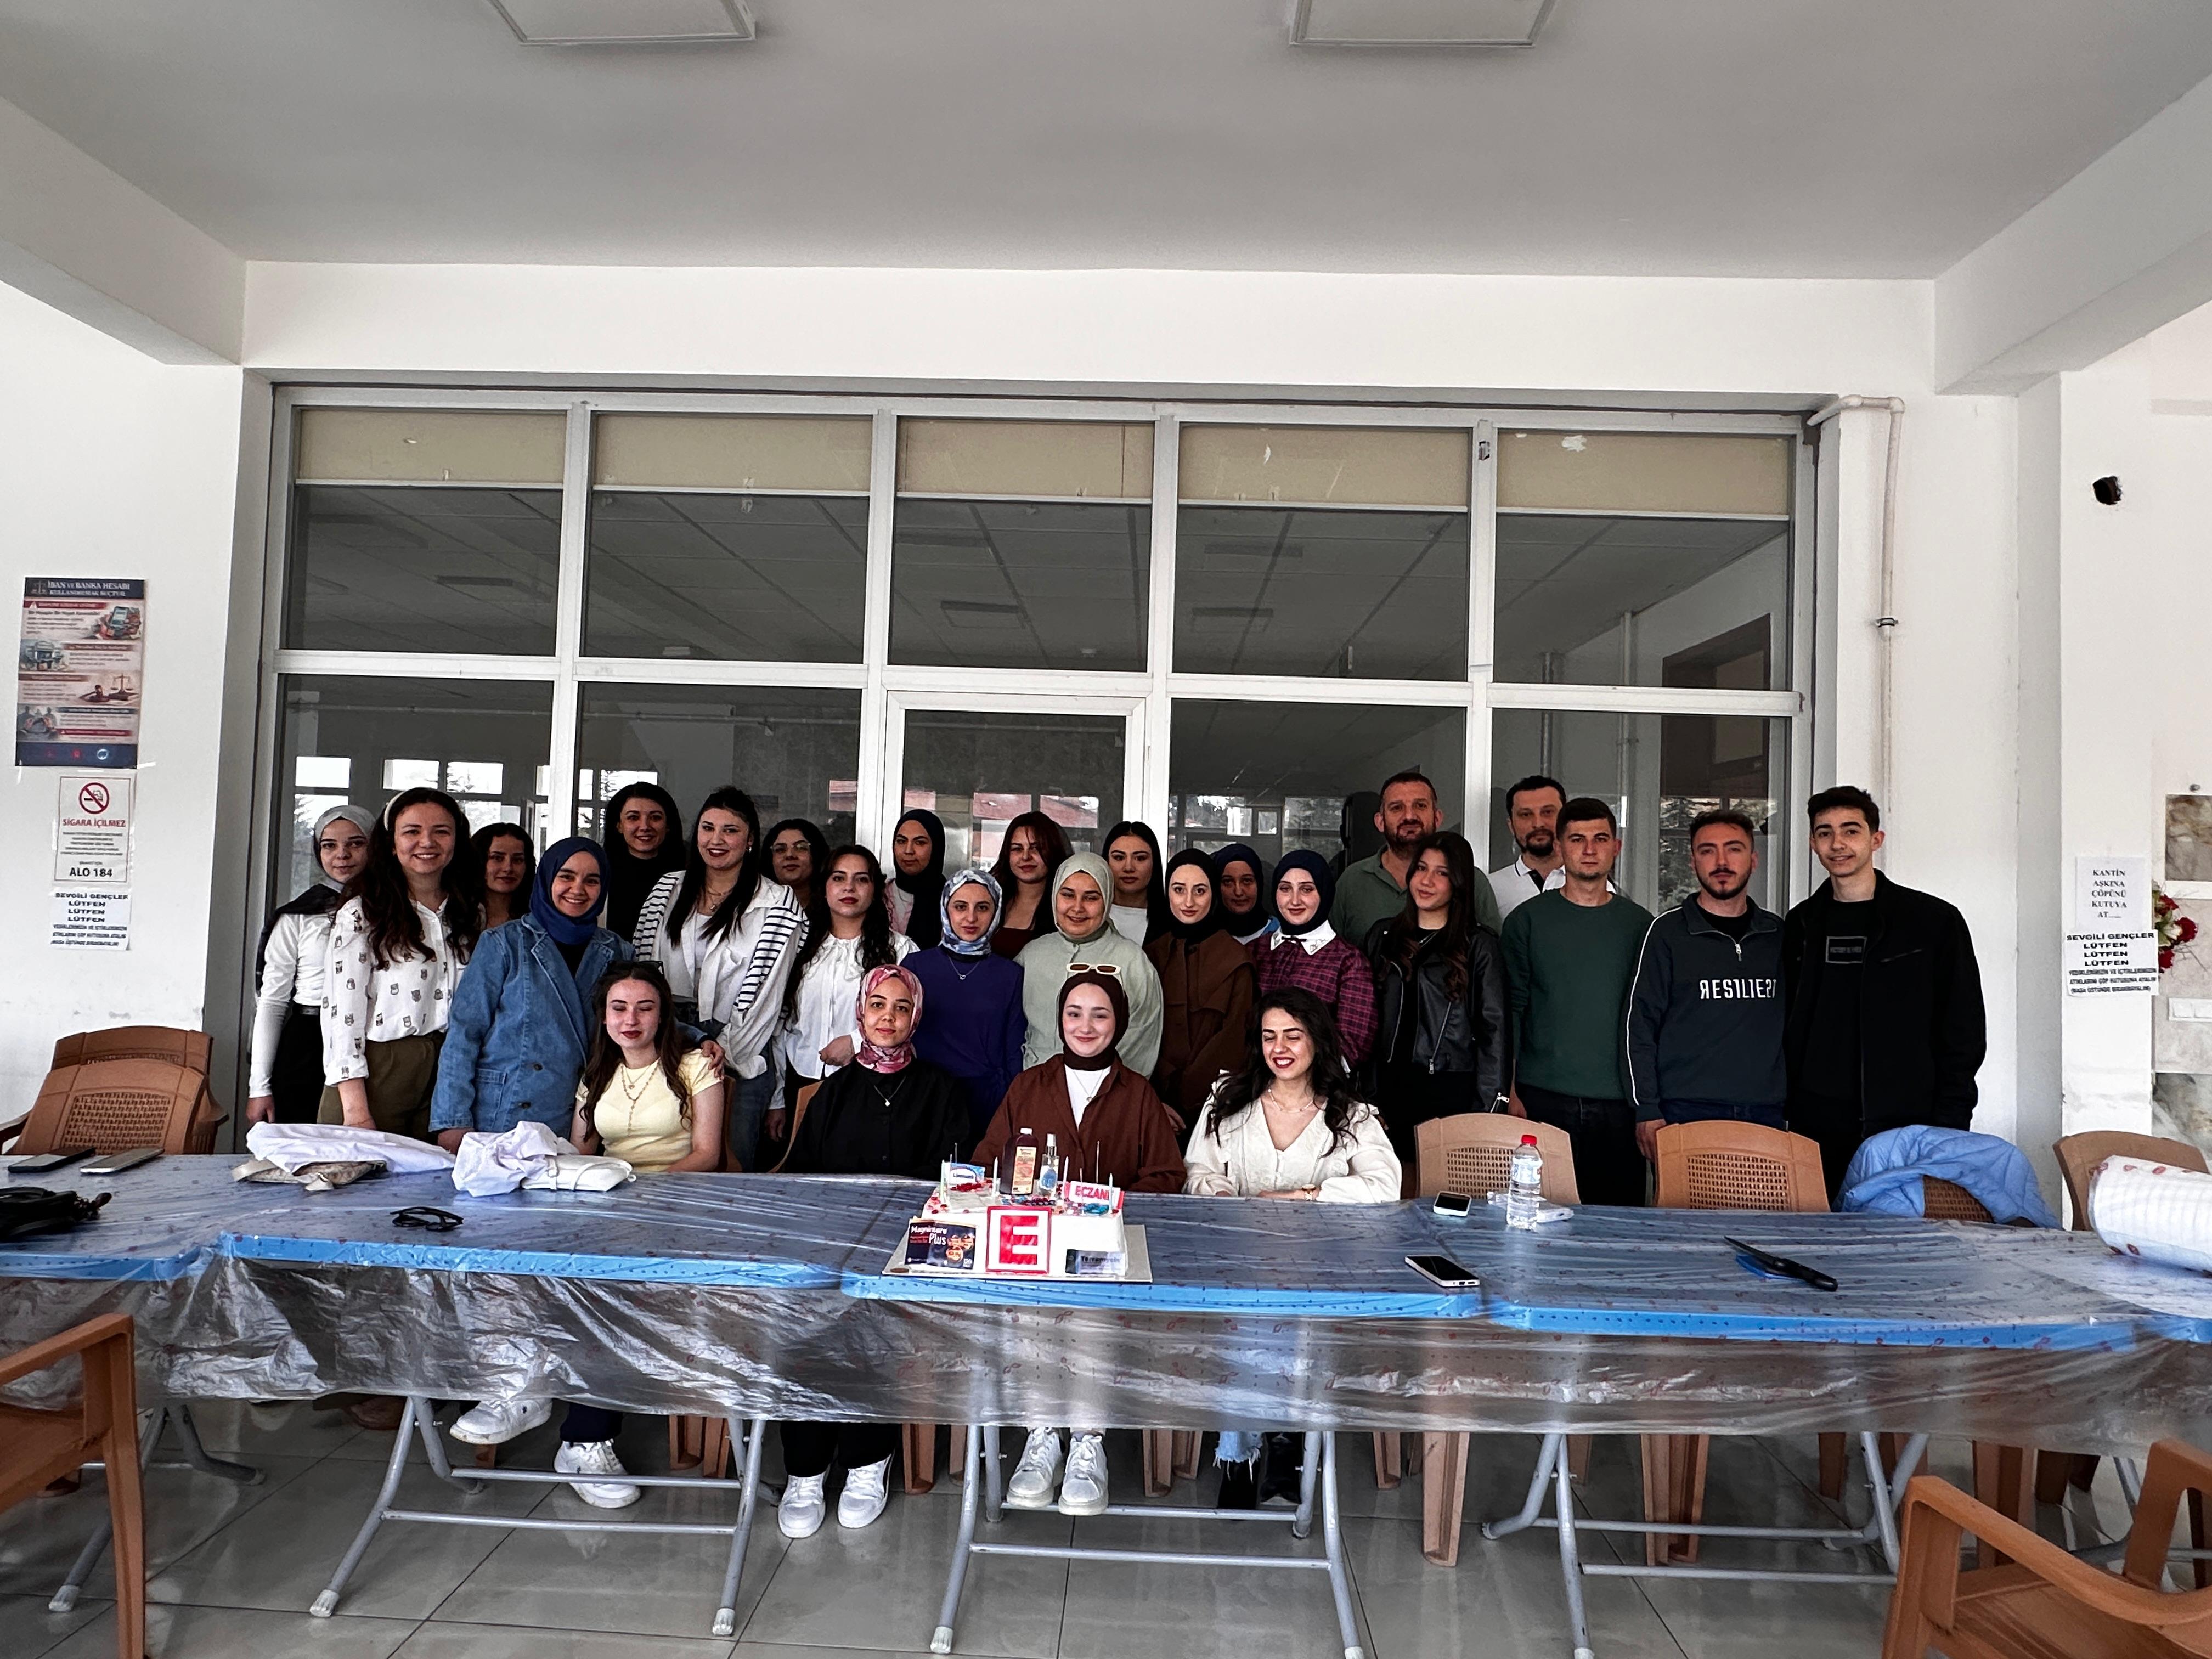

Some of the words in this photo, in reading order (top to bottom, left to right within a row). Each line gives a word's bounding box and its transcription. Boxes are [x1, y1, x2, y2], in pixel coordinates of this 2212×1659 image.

[63, 817, 92, 826] SİGARA
[94, 818, 126, 828] İÇİLMEZ
[69, 867, 91, 877] ALO
[93, 868, 113, 877] 184
[2092, 868, 2125, 877] KANTİN
[2091, 889, 2126, 898] ÇÖPÜNÜ
[928, 1232, 947, 1245] Plus
[998, 1215, 1039, 1265] E
